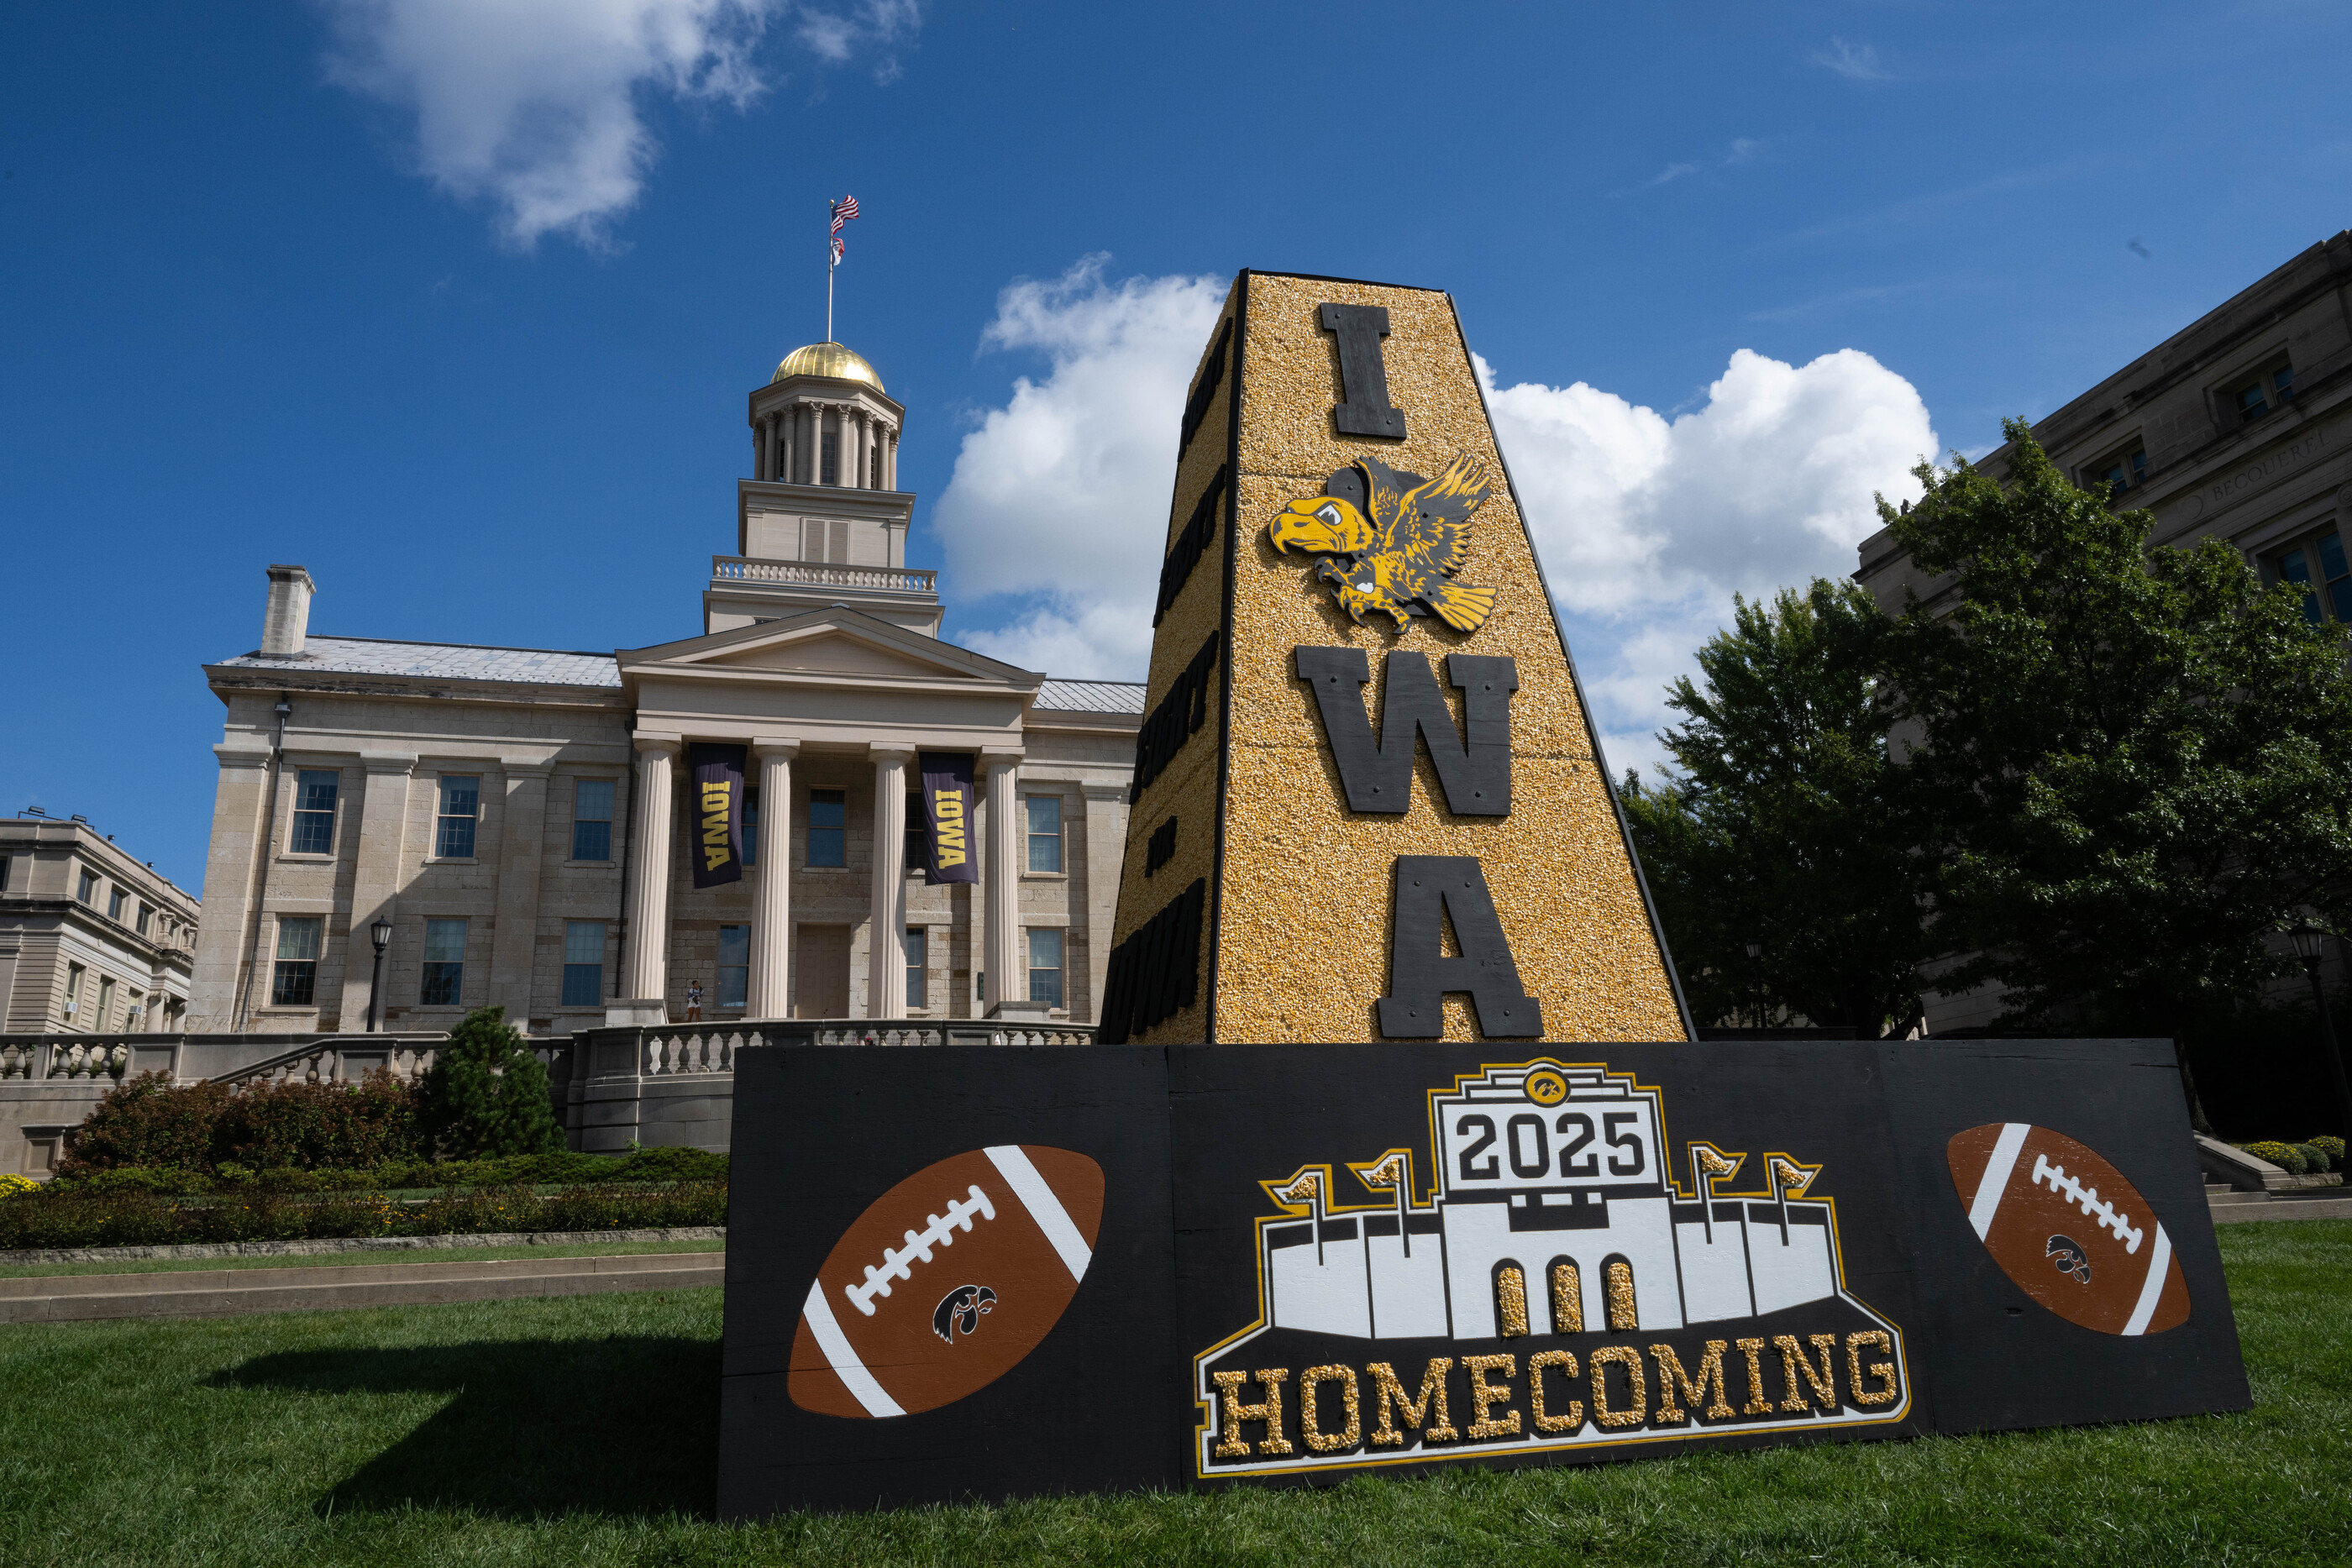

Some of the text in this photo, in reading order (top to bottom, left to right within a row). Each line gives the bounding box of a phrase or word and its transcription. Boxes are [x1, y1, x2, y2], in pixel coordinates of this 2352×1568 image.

[2211, 430, 2332, 501] BECQUEREL
[1295, 302, 1544, 1038] IWA
[701, 781, 730, 871] IOWA
[935, 789, 966, 870] IOWA
[1457, 1113, 1646, 1180] 2025
[1211, 1329, 1898, 1460] HOMECOMING
